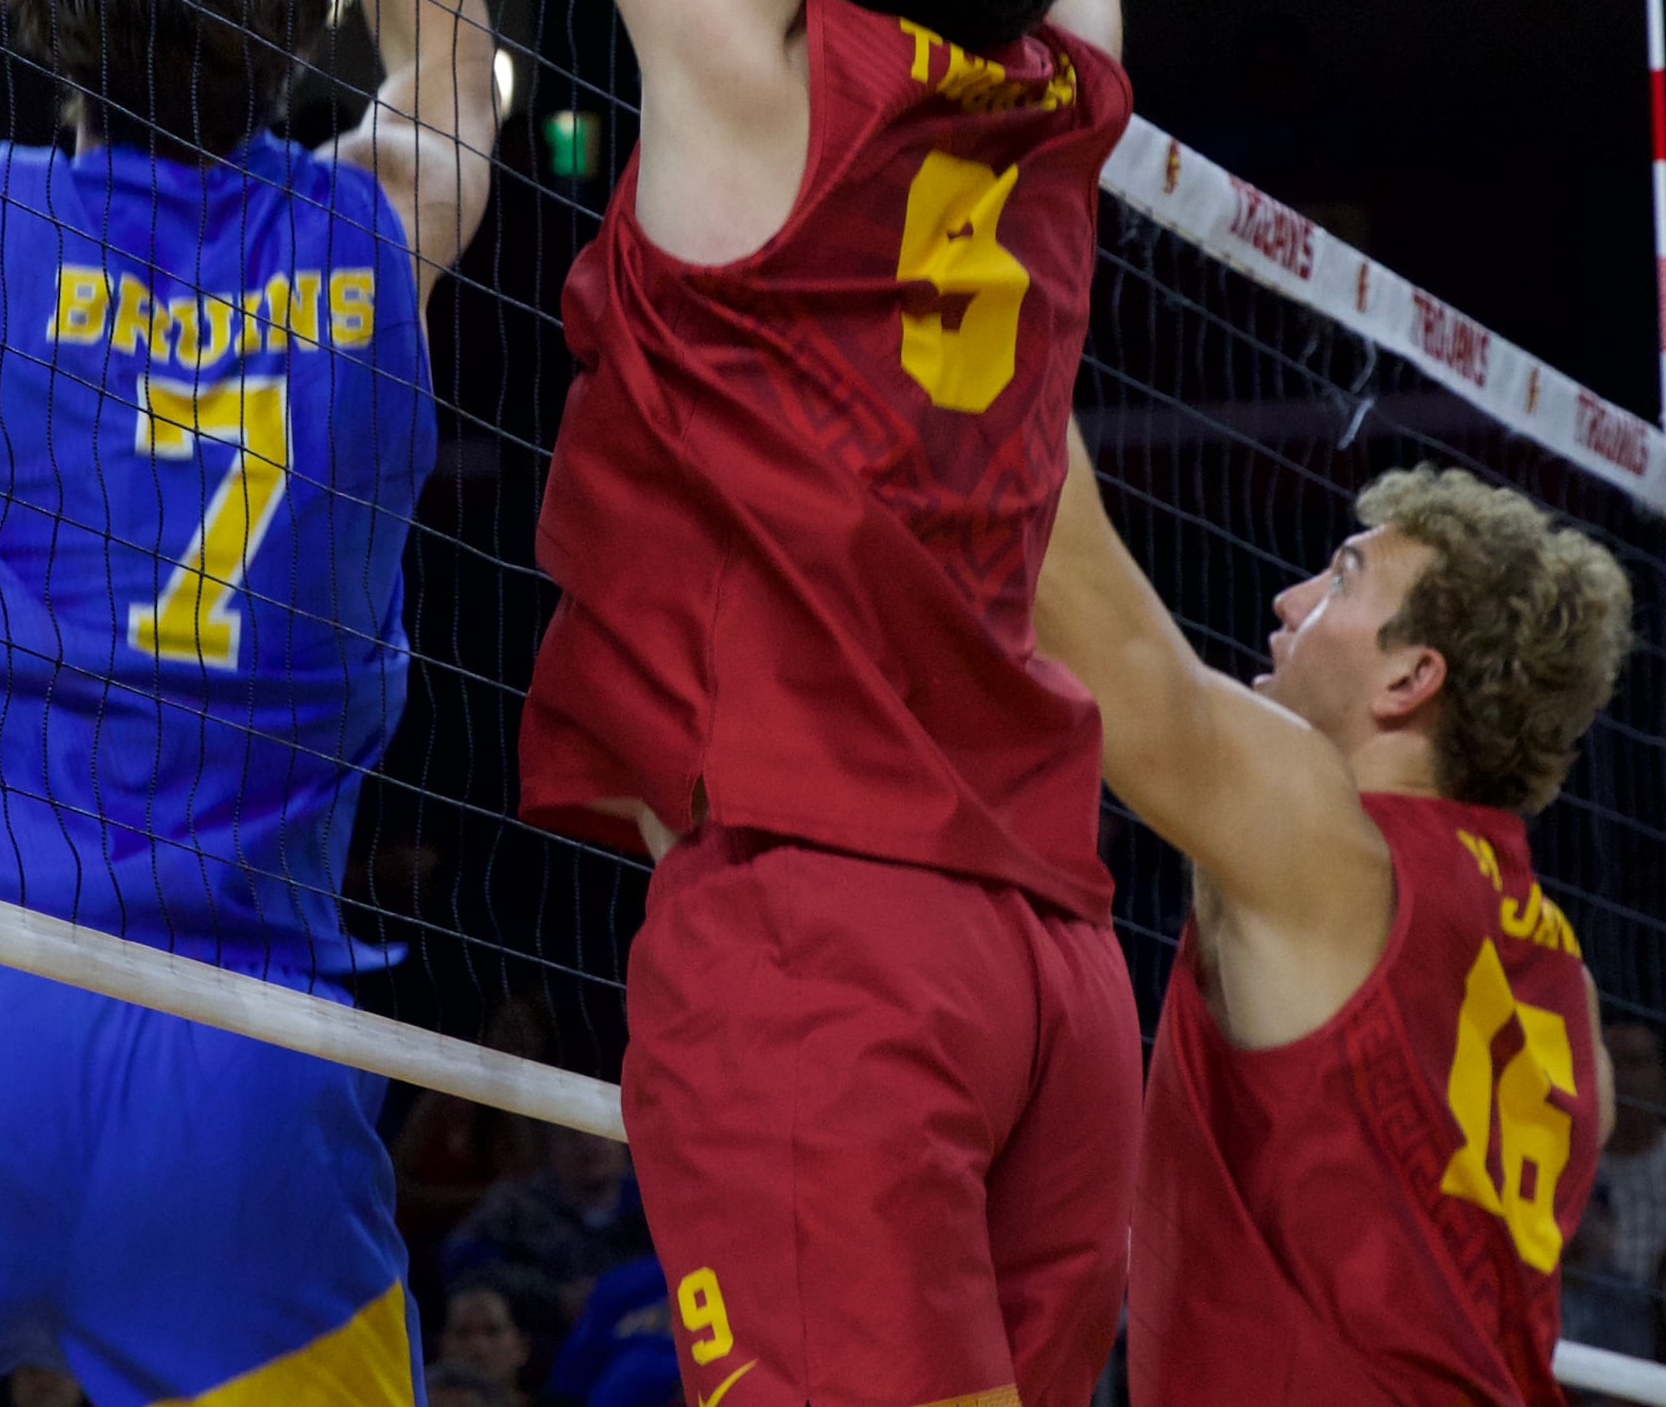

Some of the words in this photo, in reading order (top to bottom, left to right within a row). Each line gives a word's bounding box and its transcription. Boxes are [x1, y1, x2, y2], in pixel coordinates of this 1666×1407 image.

[47, 264, 375, 369] BRUINS
[128, 374, 293, 671] 7
[1441, 937, 1577, 1275] 16
[677, 1267, 733, 1365] 9
